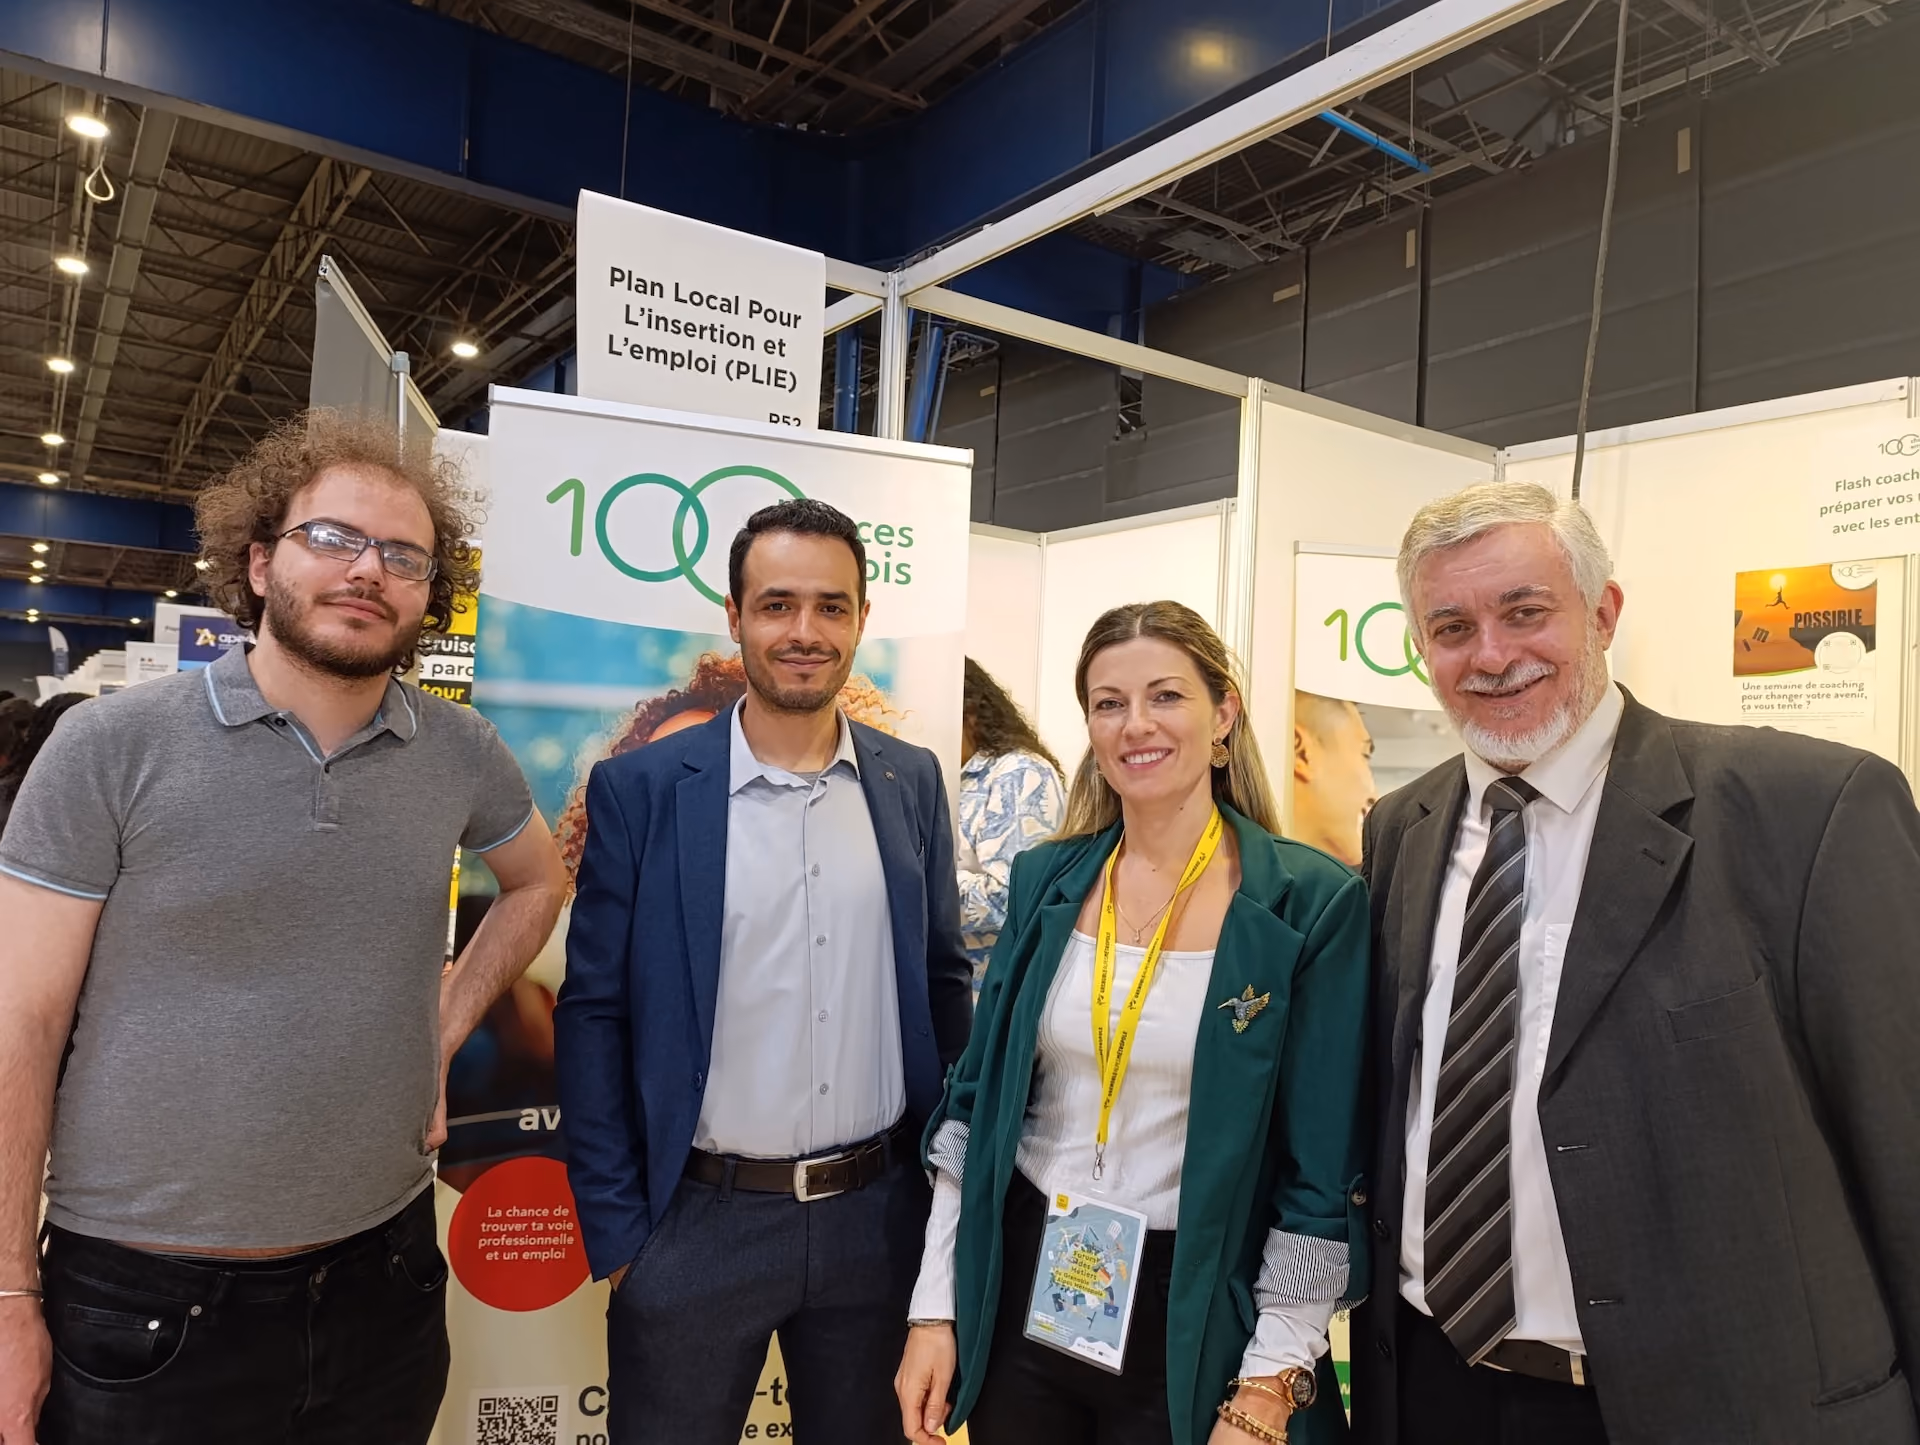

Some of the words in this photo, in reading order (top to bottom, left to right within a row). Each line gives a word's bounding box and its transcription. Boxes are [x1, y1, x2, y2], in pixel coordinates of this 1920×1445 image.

[610, 266, 664, 298] Plan
[674, 282, 740, 315] Local
[748, 299, 802, 329] Pour
[625, 304, 755, 351] L'insertion
[763, 338, 786, 357] et
[608, 334, 716, 375] L'emploi
[725, 359, 797, 393] (PLIE)
[1835, 476, 1871, 492] Flash
[1876, 468, 1920, 485] coach
[1820, 501, 1882, 518] préparer
[1887, 493, 1913, 505] vos
[857, 521, 914, 548] ces
[1832, 521, 1865, 534] avec
[1870, 517, 1890, 529] les
[865, 551, 911, 585] ois
[1794, 609, 1863, 628] POSSIBLE
[1742, 682, 1761, 690] Une
[1764, 682, 1802, 690] semaine
[1805, 681, 1817, 689] de
[1820, 680, 1865, 691] coaching
[1741, 693, 1763, 703] pour
[1765, 692, 1803, 702] changer
[518, 1108, 561, 1130] av
[488, 1207, 502, 1217] La
[506, 1206, 549, 1217] chance
[553, 1205, 569, 1216] de
[481, 1222, 528, 1232] trouver
[531, 1221, 544, 1231] ta
[547, 1220, 574, 1230] voie
[478, 1233, 574, 1249] professionnelle
[485, 1251, 499, 1261] et
[503, 1251, 518, 1260] un
[522, 1248, 566, 1262] emploi
[576, 1433, 607, 1445] no
[766, 1423, 793, 1438] ex
